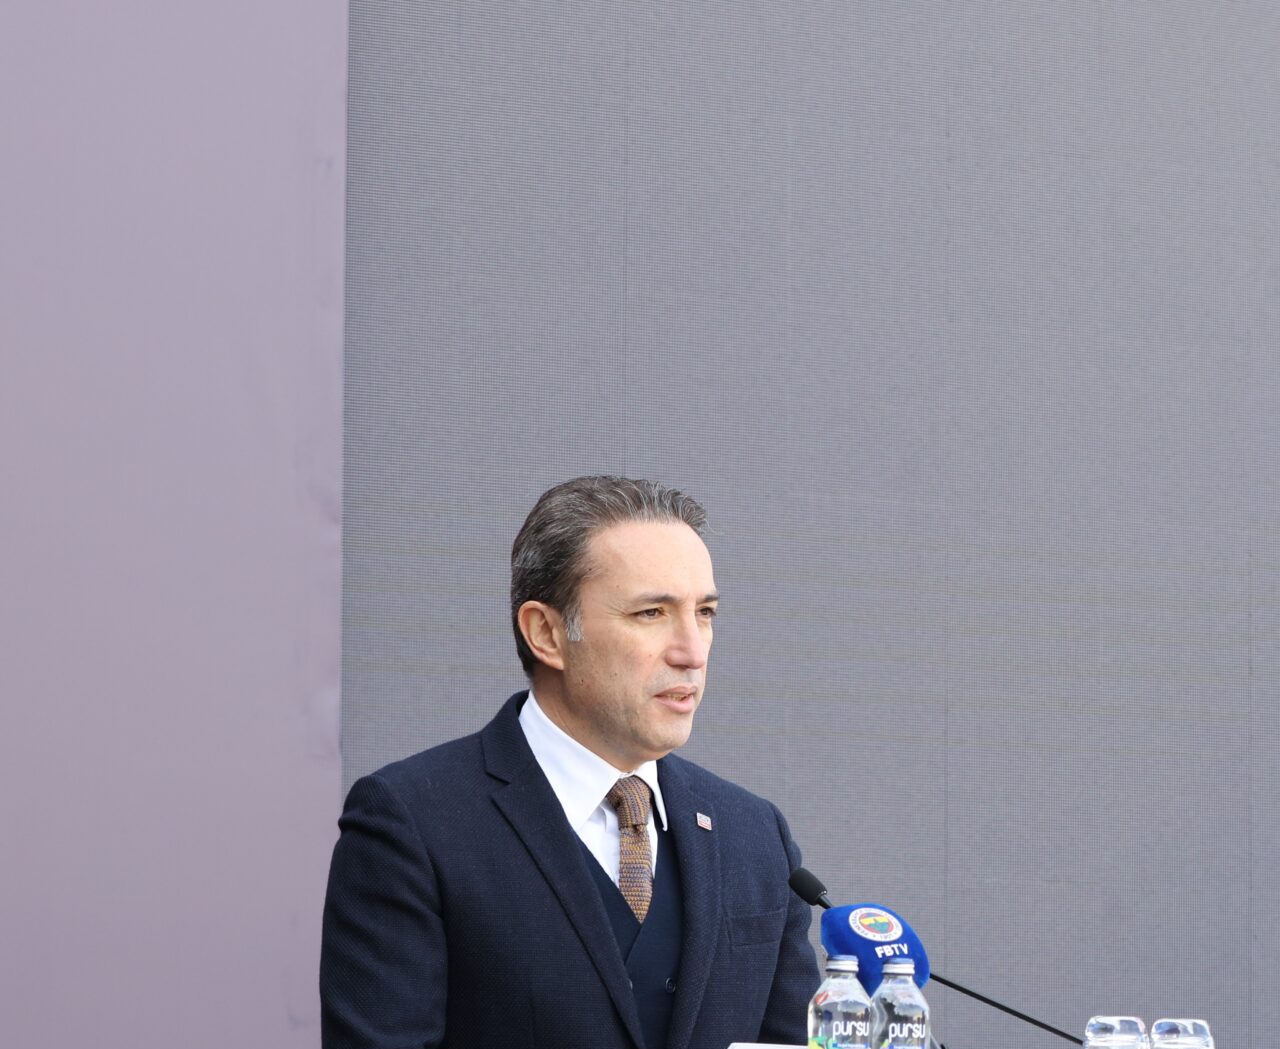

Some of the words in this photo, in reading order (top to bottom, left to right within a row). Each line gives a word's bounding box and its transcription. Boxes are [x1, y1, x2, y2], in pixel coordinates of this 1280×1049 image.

[874, 942, 909, 959] FBTV
[832, 1020, 870, 1042] pursu
[888, 1022, 926, 1044] pursu
